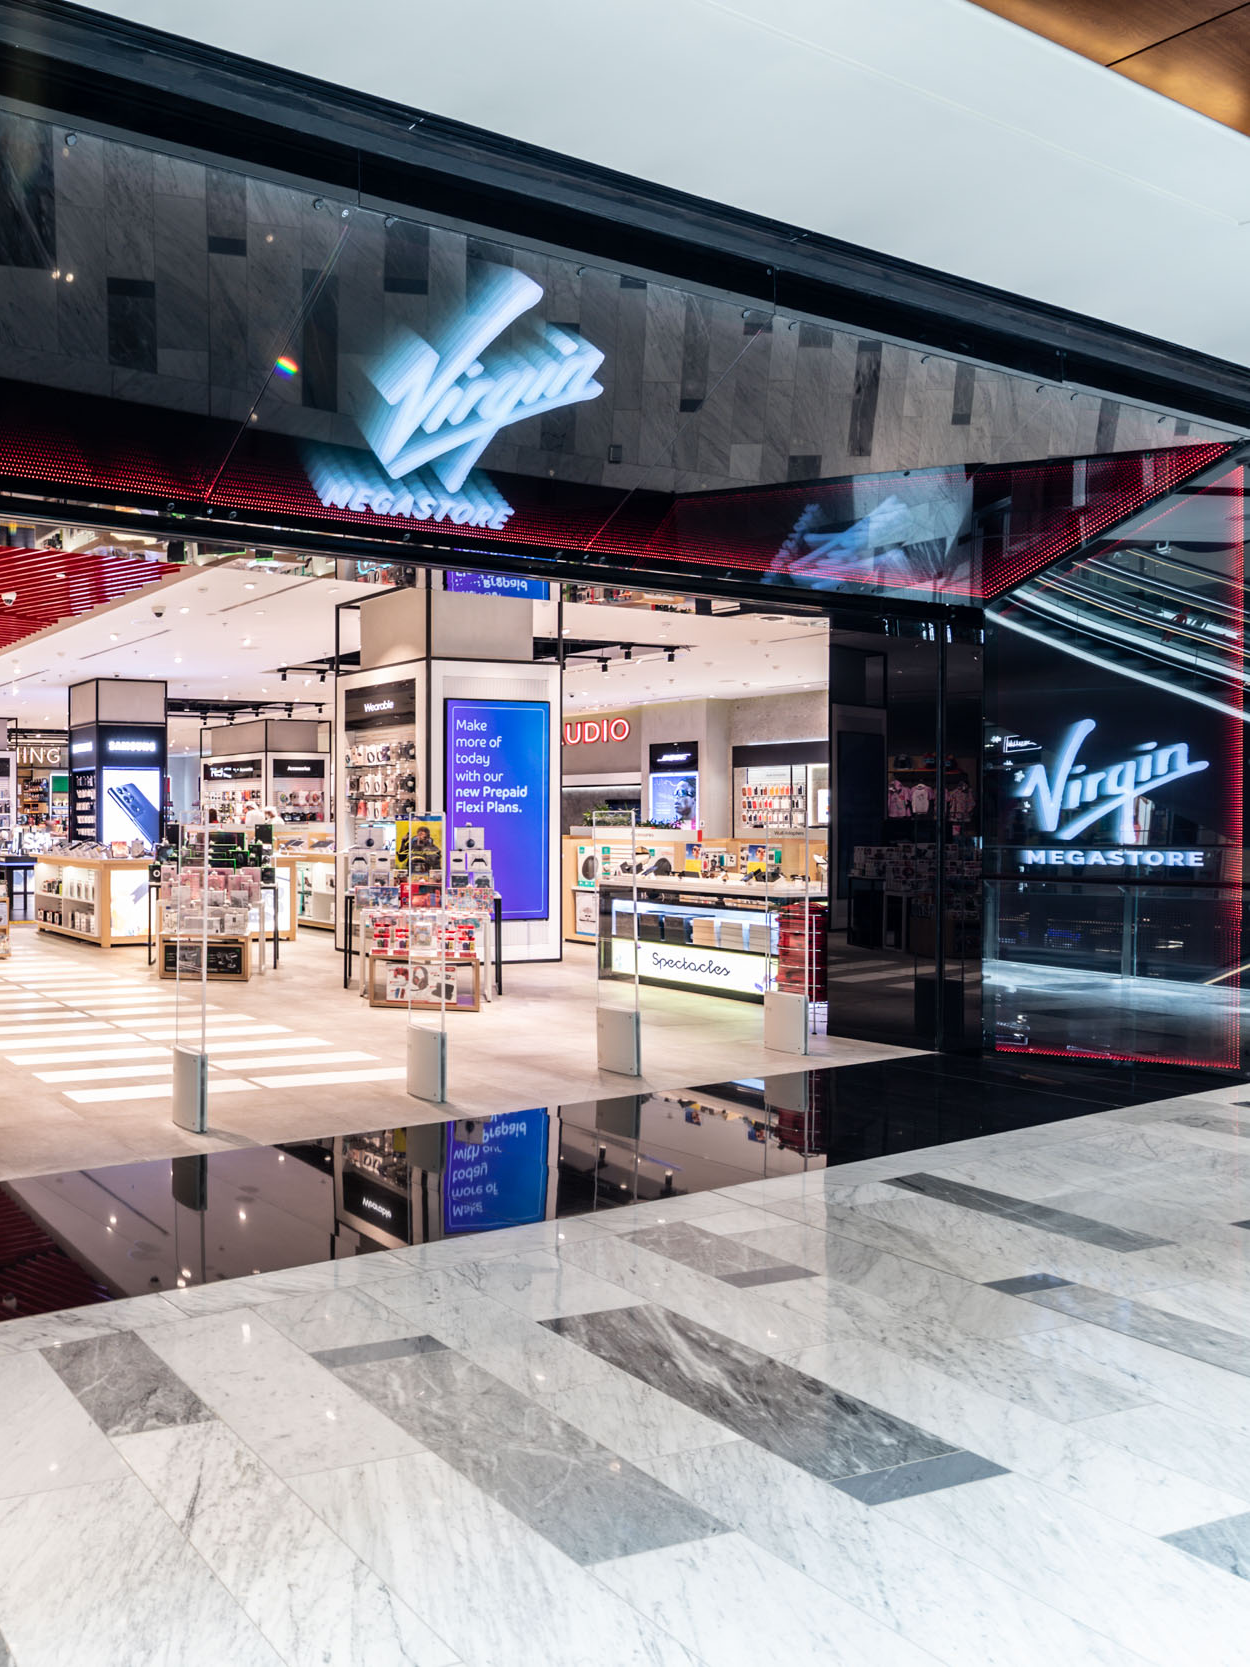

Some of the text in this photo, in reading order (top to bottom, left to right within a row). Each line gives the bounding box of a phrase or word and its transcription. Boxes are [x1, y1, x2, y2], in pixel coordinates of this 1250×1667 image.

[358, 267, 606, 494] Virgin
[314, 470, 516, 531] MEGASTORE
[363, 700, 395, 712] Wearable
[455, 719, 488, 731] Make
[561, 717, 631, 746] UDIO
[455, 735, 503, 748] more of
[455, 752, 490, 767] today
[455, 770, 504, 782] with our
[1017, 718, 1211, 844] Virgin
[455, 785, 528, 800] new Prepaid
[455, 801, 523, 813] Flexi Plans.
[1020, 850, 1205, 868] MEGASTORE
[652, 952, 731, 977] Spectacles
